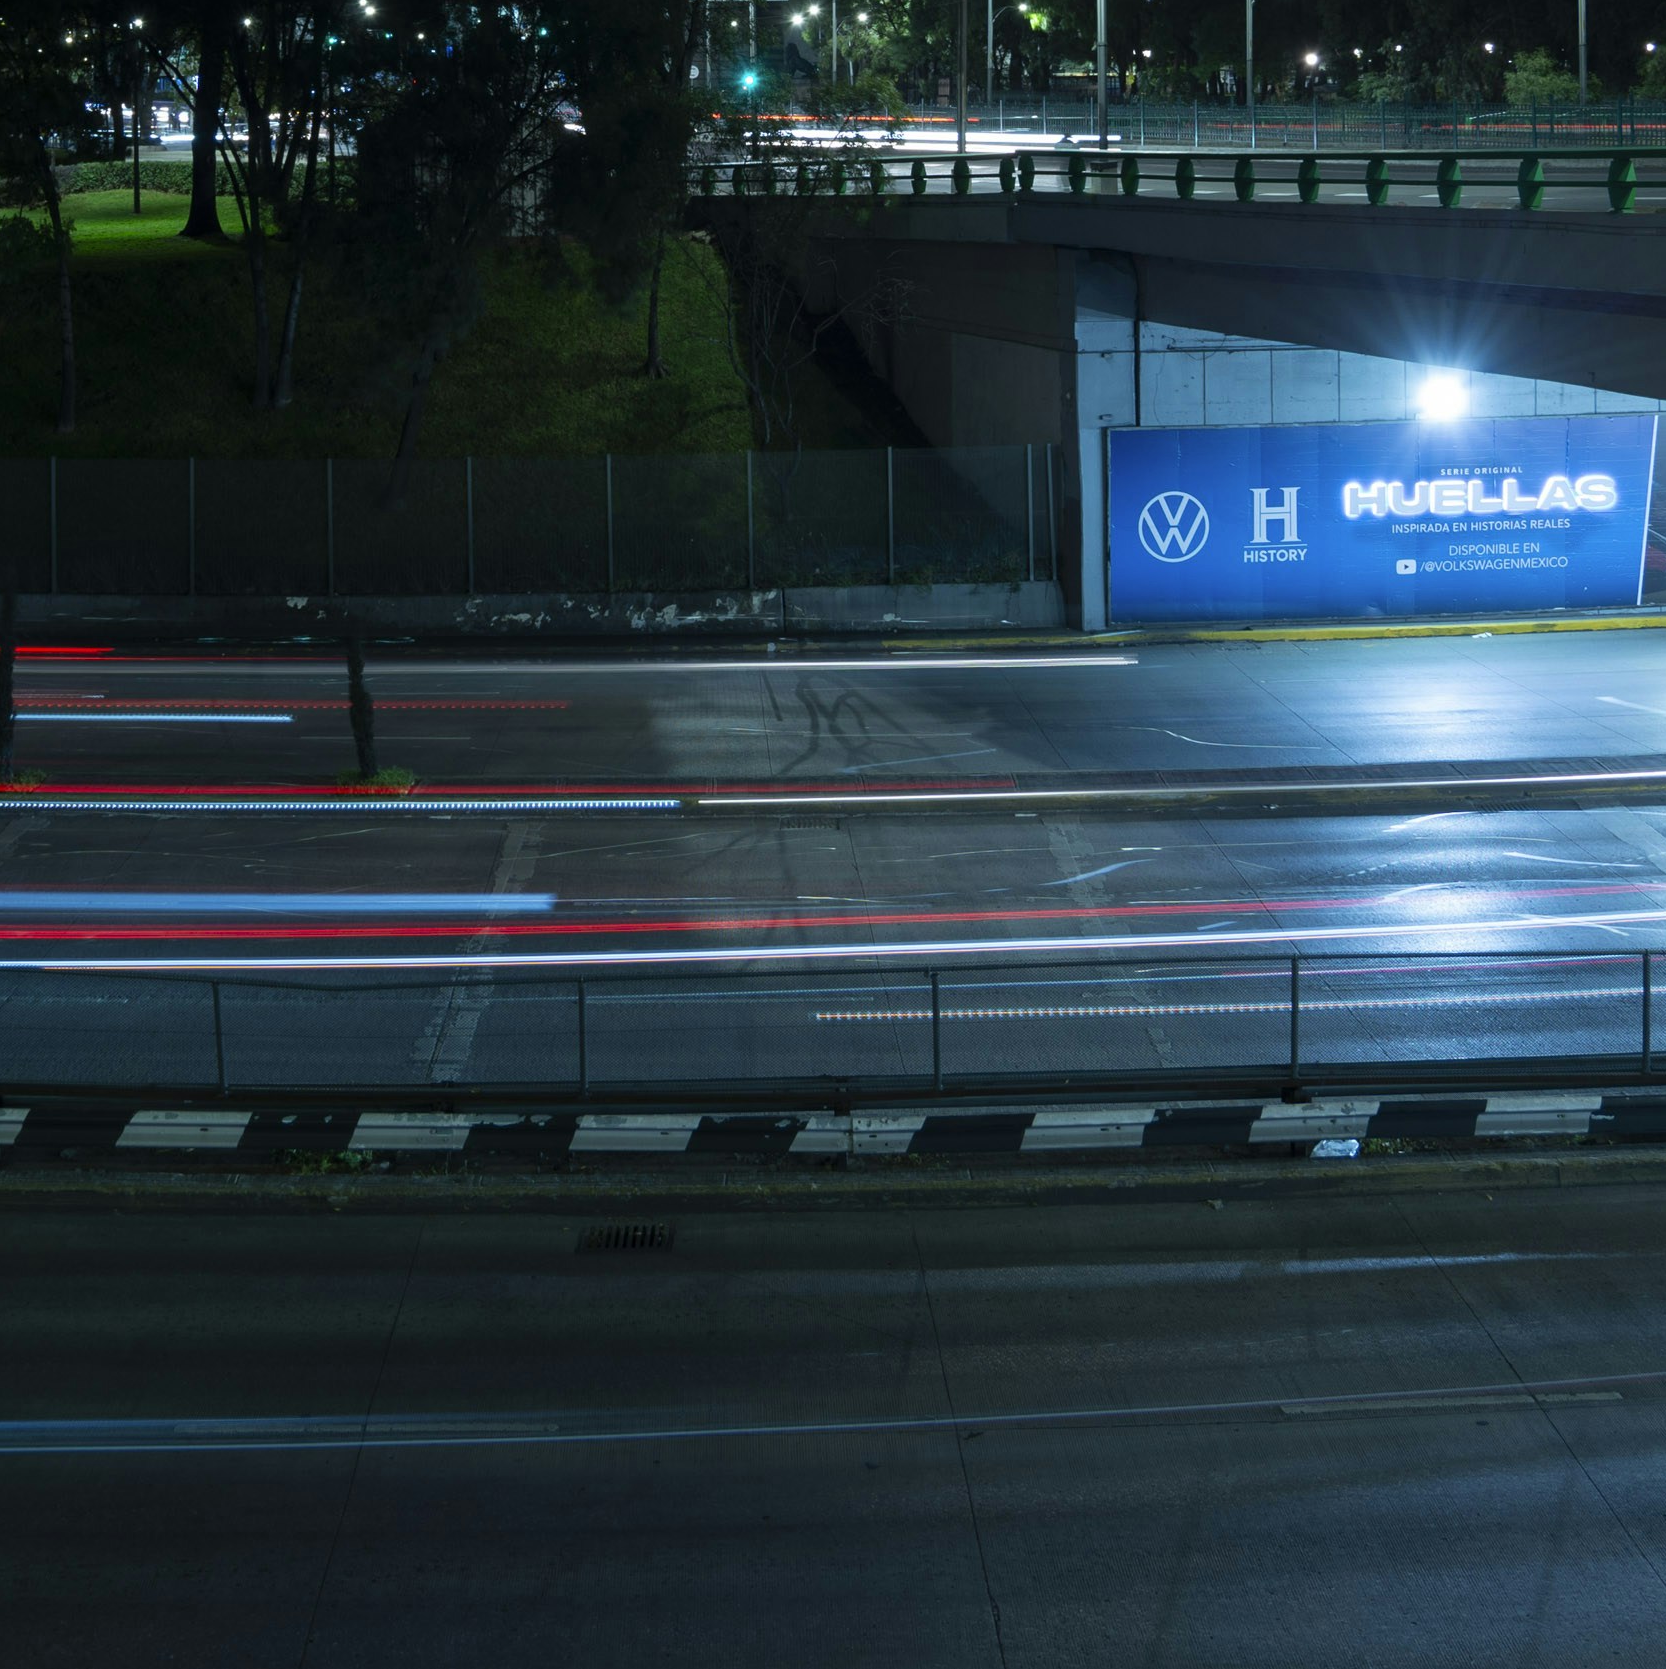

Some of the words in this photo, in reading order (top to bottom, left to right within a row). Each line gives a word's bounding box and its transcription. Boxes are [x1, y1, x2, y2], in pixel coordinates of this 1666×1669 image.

[1440, 467, 1470, 476] SERIE
[1474, 466, 1523, 475] ORIGINAL
[1344, 475, 1617, 518] HUELLAS
[1391, 523, 1450, 534] INSPIRADA
[1453, 522, 1467, 532] EN
[1470, 520, 1527, 531] HISTORIAS
[1531, 519, 1571, 529] REALES
[1244, 549, 1308, 563] HISTORY
[1449, 543, 1520, 556] DISPONIBLE
[1523, 542, 1540, 553] EN
[1420, 557, 1568, 572] /@VOLKSWAGENMEXICO
